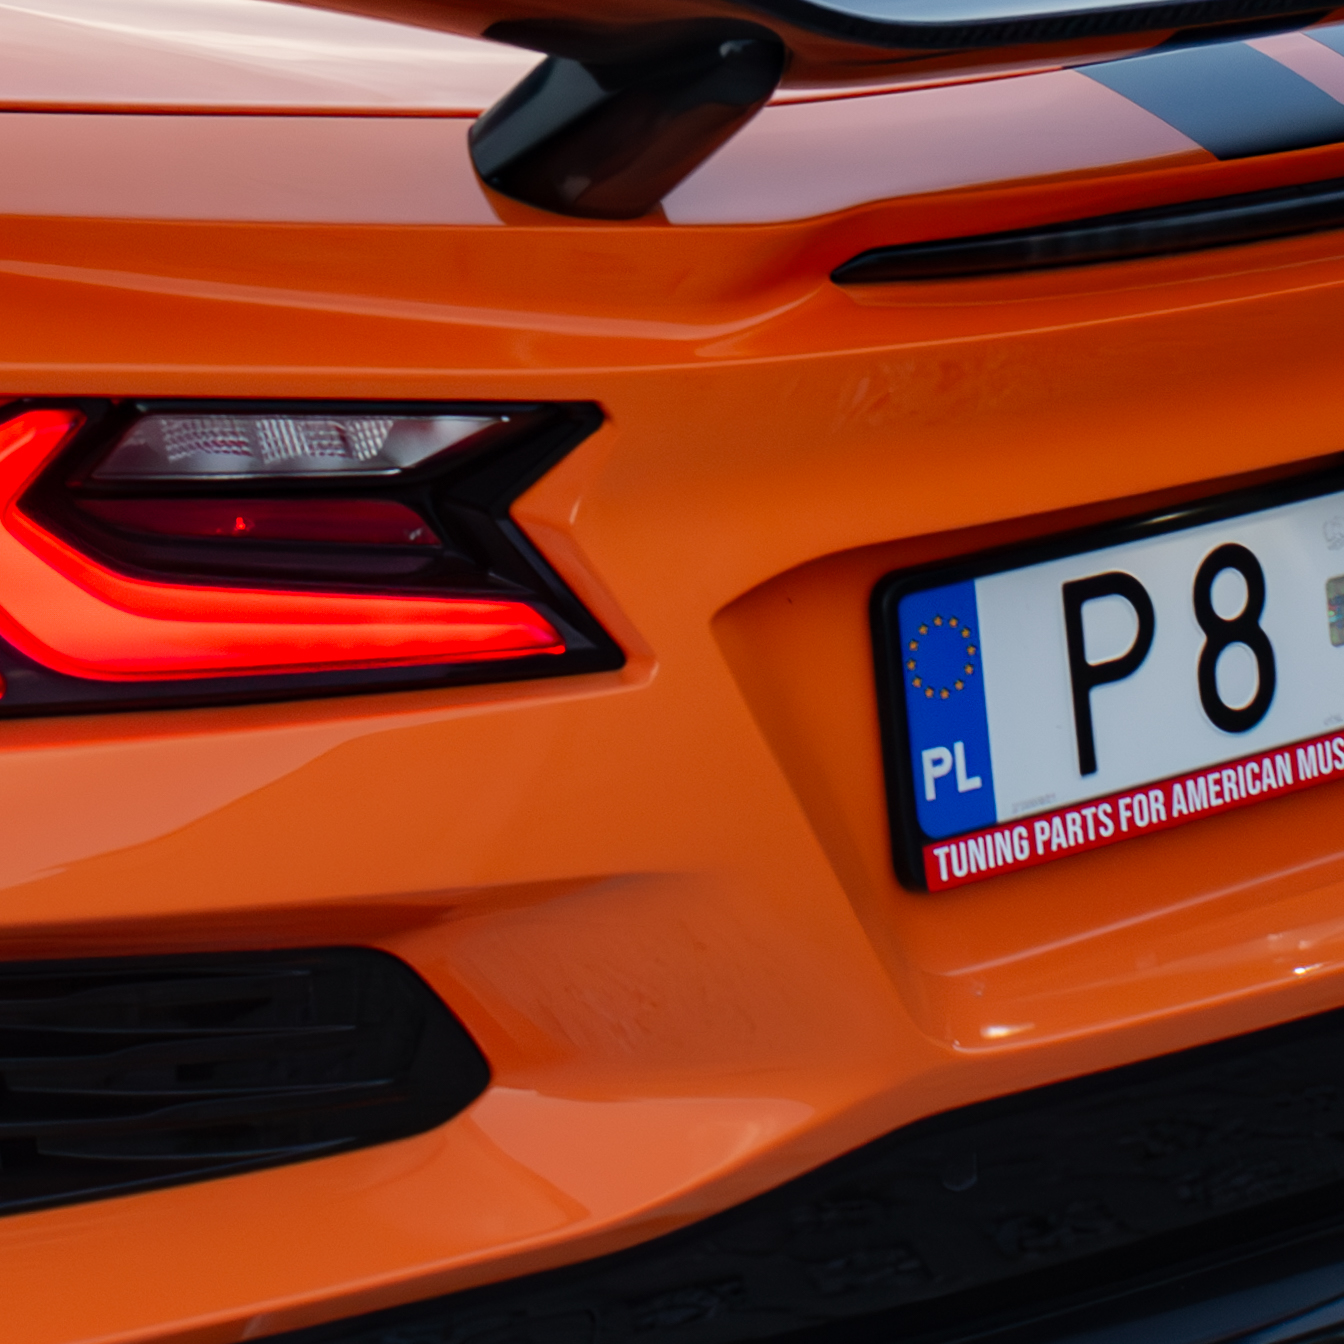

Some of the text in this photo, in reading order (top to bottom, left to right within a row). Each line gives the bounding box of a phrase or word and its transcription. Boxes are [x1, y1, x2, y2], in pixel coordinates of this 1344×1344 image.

[1061, 542, 1277, 777] P8
[921, 741, 983, 801] PL
[933, 825, 1030, 882] TUNING
[1033, 802, 1115, 855] PARTS
[1118, 788, 1167, 832] FOR
[1171, 752, 1294, 818] AMERICAN
